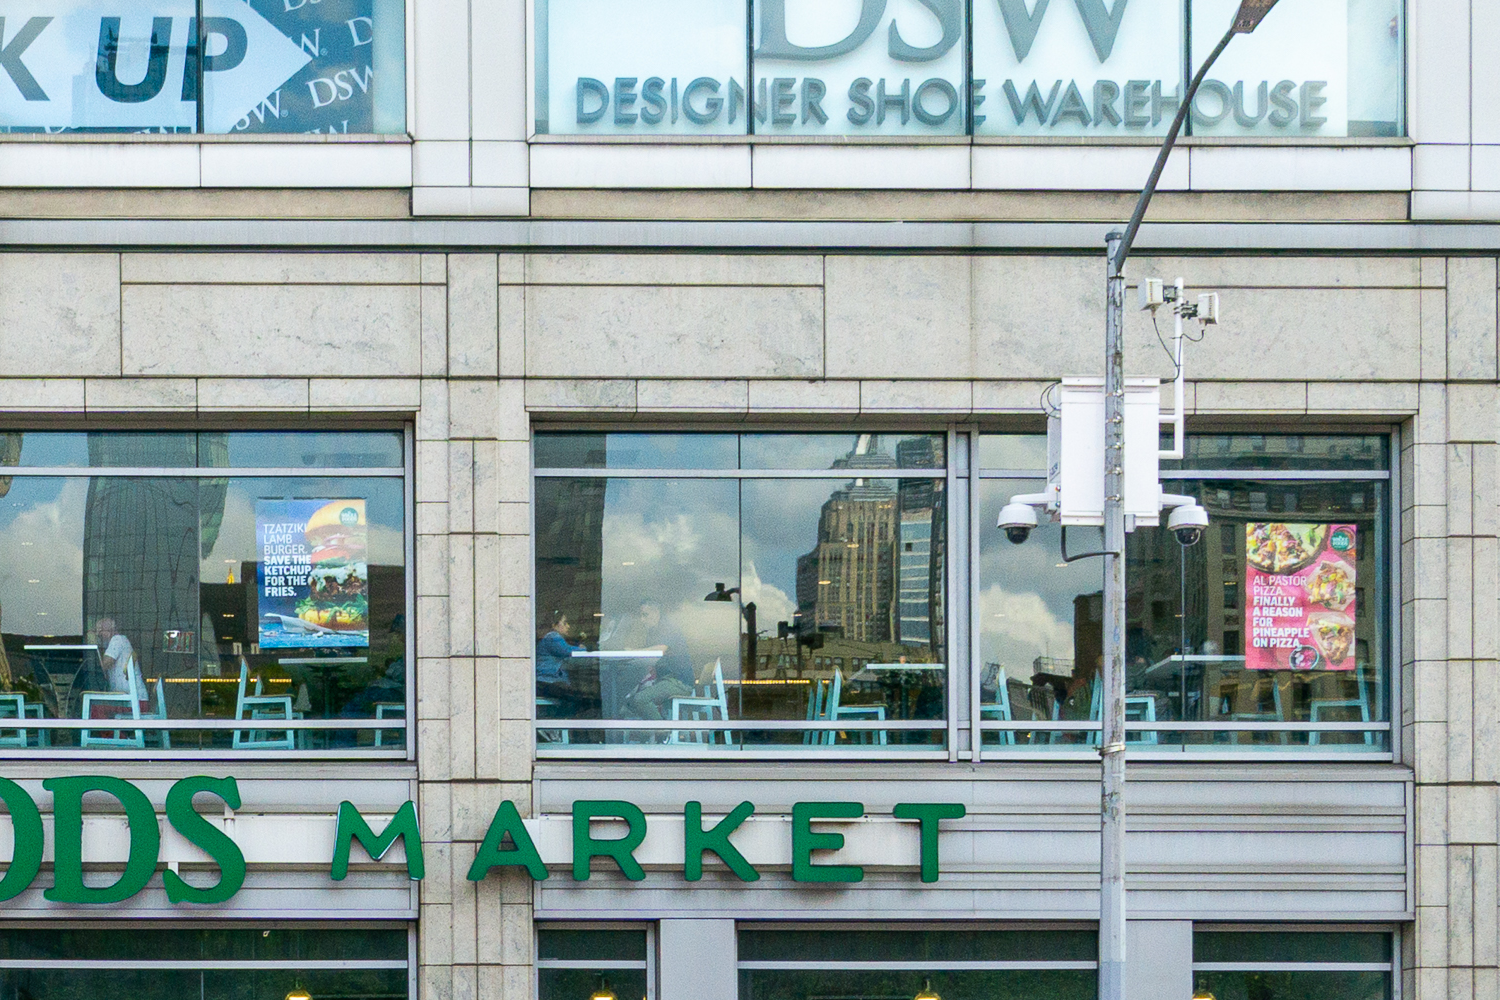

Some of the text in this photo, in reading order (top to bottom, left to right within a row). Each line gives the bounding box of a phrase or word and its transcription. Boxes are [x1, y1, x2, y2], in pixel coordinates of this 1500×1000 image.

[96, 16, 248, 103] UP
[576, 76, 1328, 128] DESIGNER SHOE WAREHOUSE
[263, 523, 307, 534] TZATZIKI
[263, 534, 293, 544] LAMB
[264, 544, 307, 555] BURGER.
[264, 555, 312, 566] SAVE THE
[264, 565, 312, 576] KETCHUP
[265, 576, 307, 586] FOR THE
[1253, 576, 1307, 586] AL PASTOR
[265, 586, 297, 597] FRIES.
[1253, 586, 1285, 596] PIZZA.
[1253, 596, 1296, 607] FINALLY
[1252, 607, 1303, 617] A REASON
[1253, 617, 1274, 627] FOR
[1253, 628, 1310, 638] PINEAPPLE
[1253, 638, 1303, 648] ON PIZZA.
[330, 800, 966, 883] MARKET
